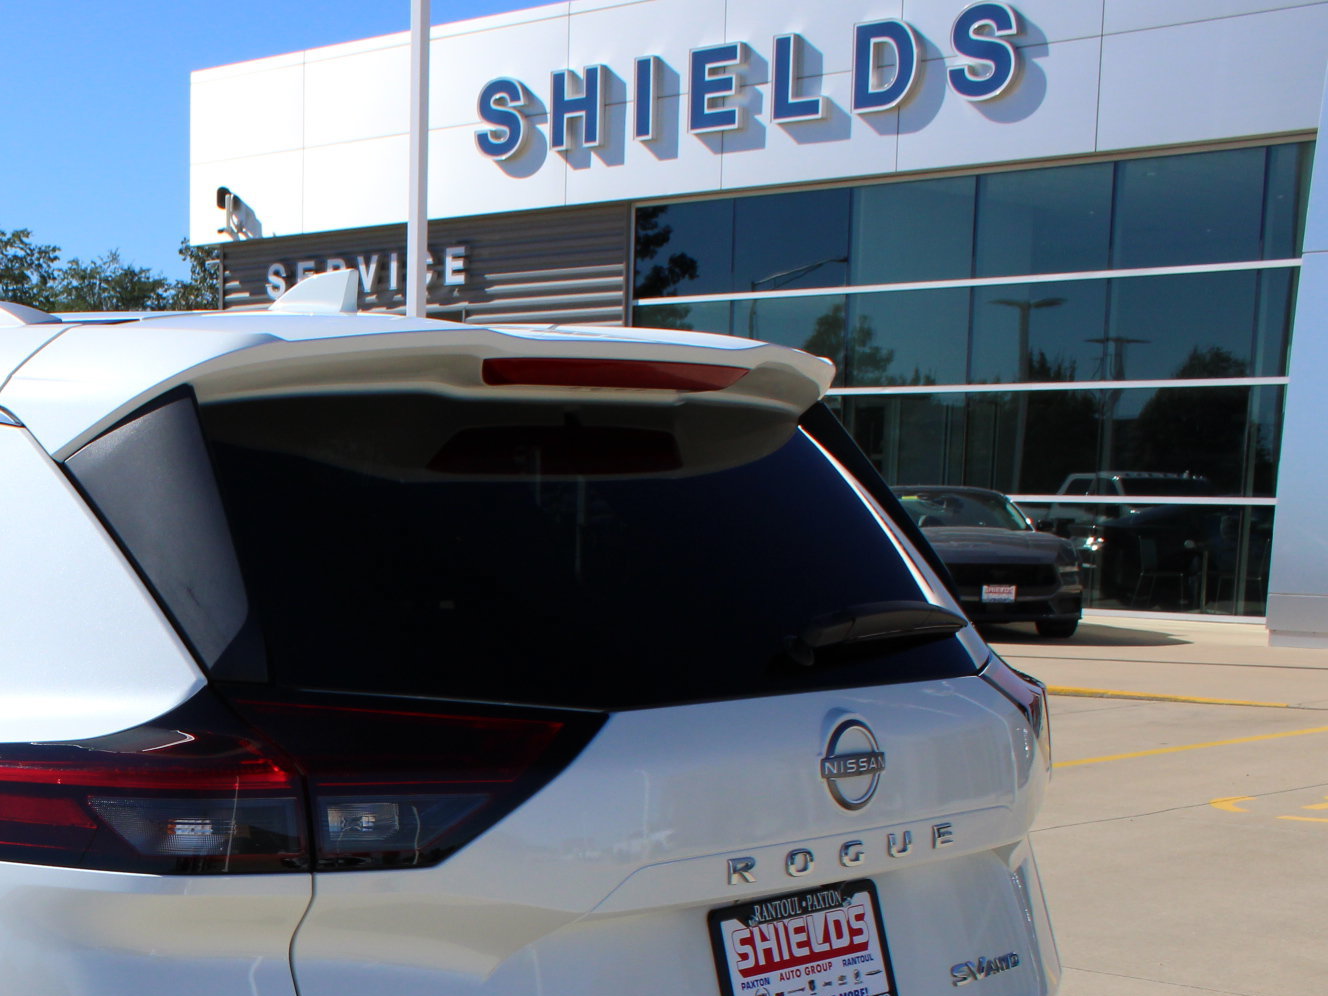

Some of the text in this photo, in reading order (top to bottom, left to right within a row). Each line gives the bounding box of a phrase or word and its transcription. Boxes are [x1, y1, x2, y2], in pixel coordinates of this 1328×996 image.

[474, 1, 1019, 160] SHIELDS
[824, 756, 885, 774] NISSAN
[728, 822, 954, 885] ROGUE
[753, 889, 843, 923] RANTOUL PAXTON
[732, 904, 870, 973] SHIELDS
[779, 961, 833, 982] AUTO GROUP
[842, 953, 874, 968] RANTOUL
[740, 977, 771, 991] PAXTON
